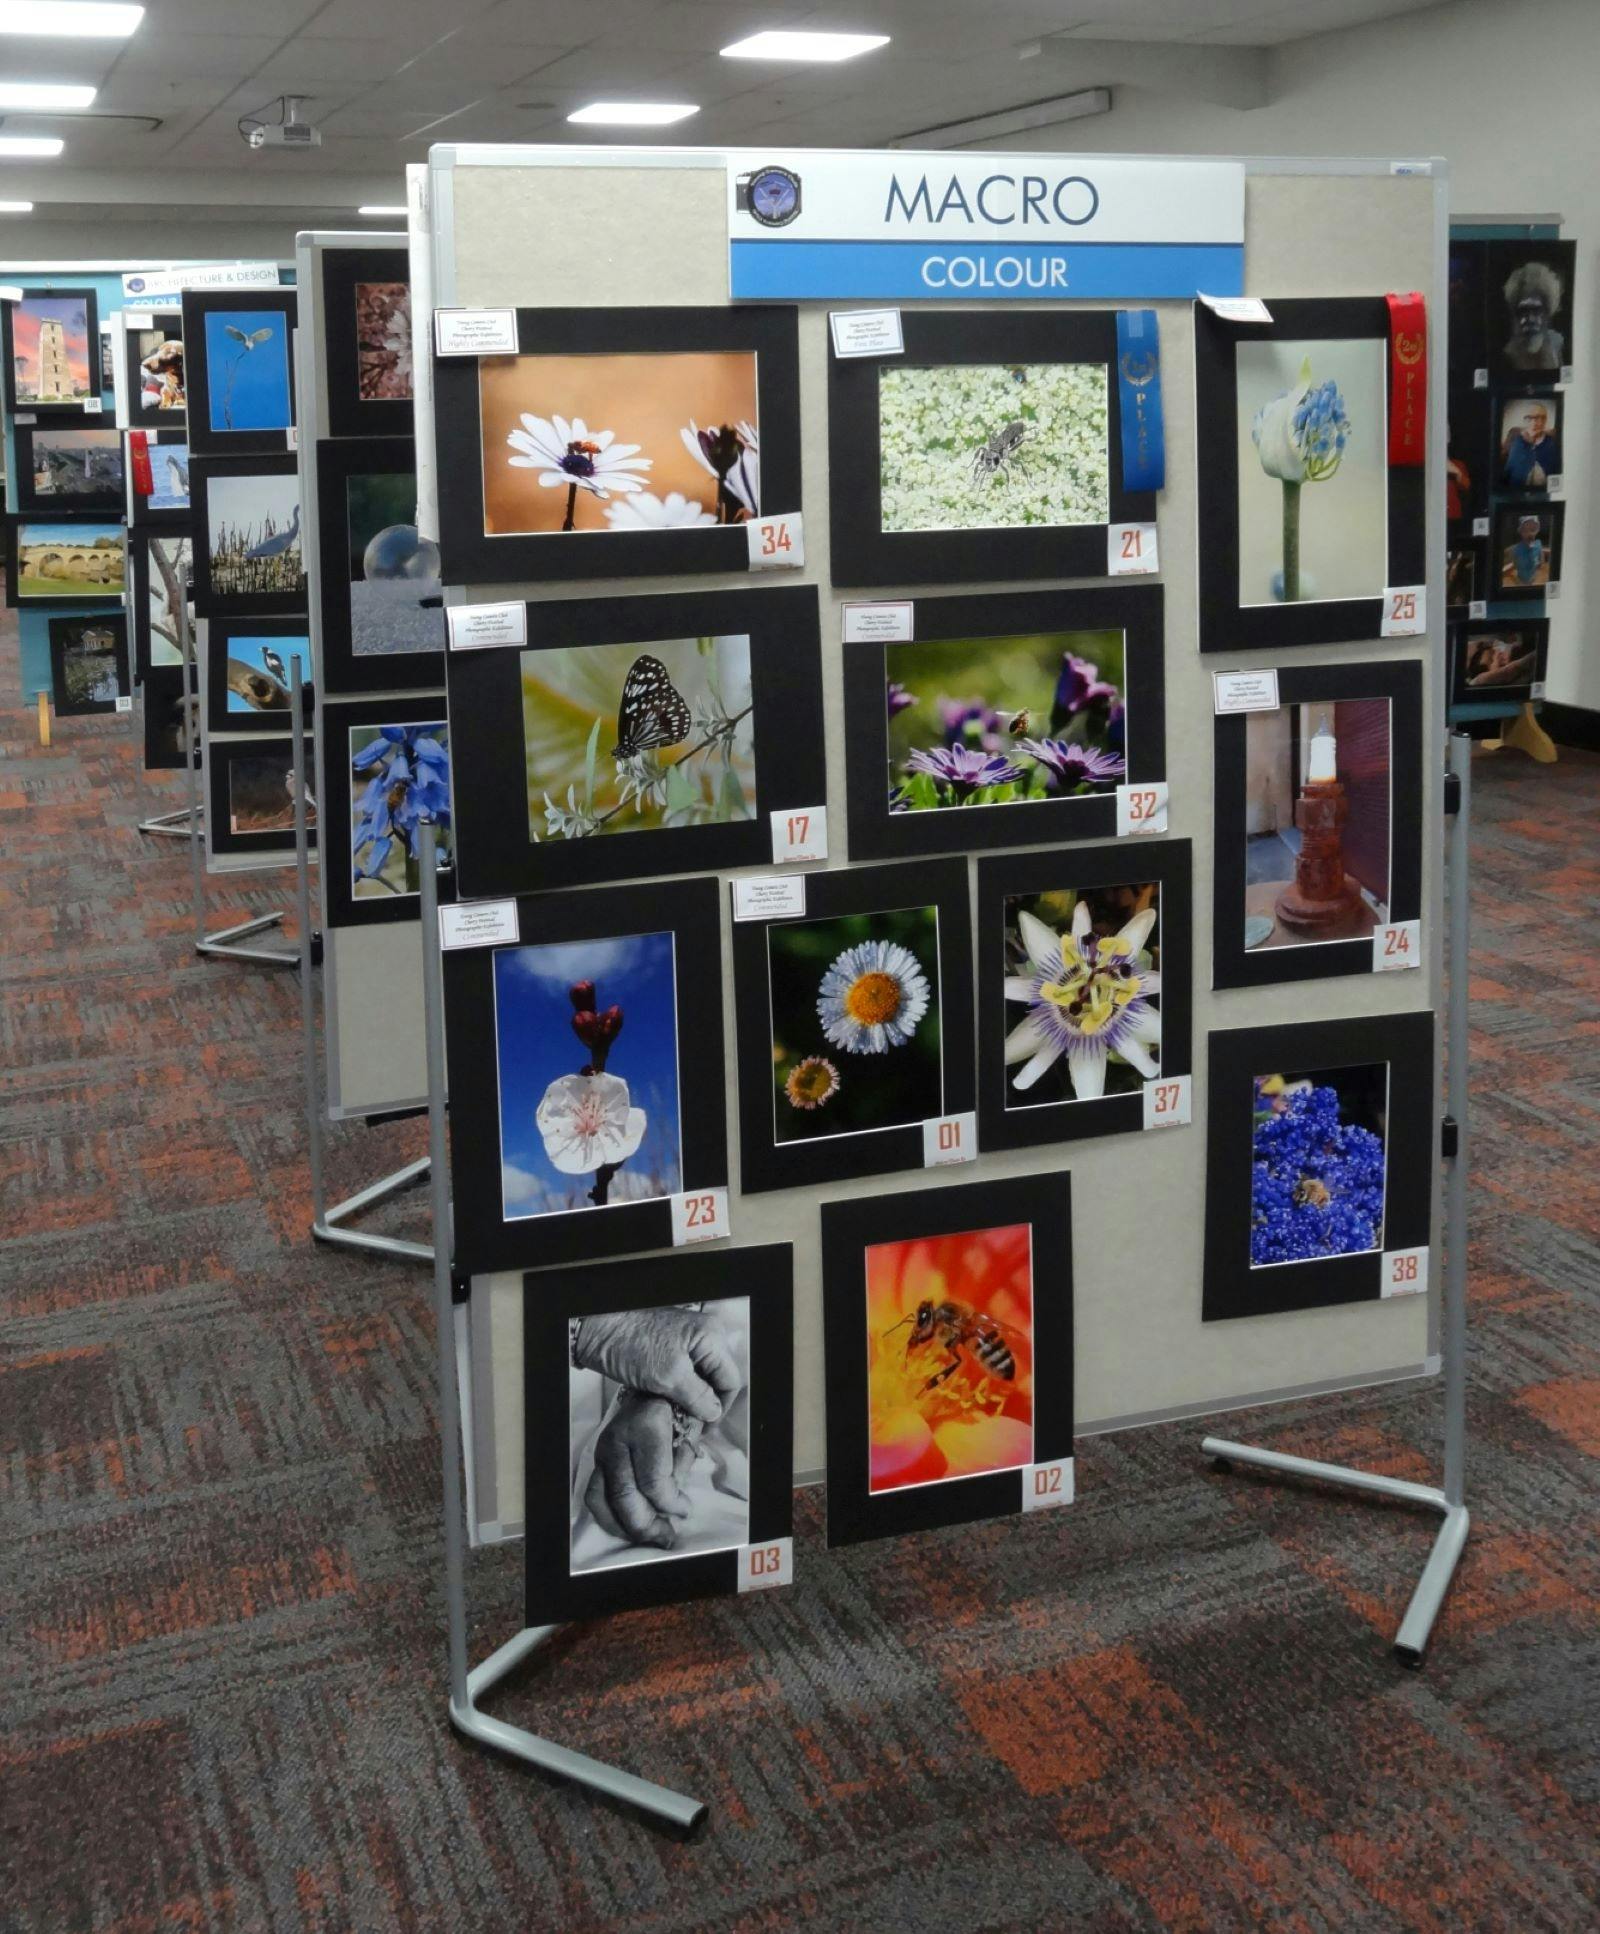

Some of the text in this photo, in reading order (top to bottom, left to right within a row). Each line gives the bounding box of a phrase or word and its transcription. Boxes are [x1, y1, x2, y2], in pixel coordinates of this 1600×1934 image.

[884, 173, 1099, 226] MACRO
[237, 269, 276, 282] DESIGN
[921, 256, 1068, 289] COLOUR
[1403, 372, 1416, 446] PLACE
[761, 523, 791, 556] 34
[1121, 530, 1142, 558] 21
[1391, 593, 1416, 620] 25
[1130, 791, 1157, 820] 32
[787, 815, 810, 845] 17
[1384, 927, 1409, 956] 24
[1154, 1083, 1181, 1113] 37
[939, 1121, 961, 1150] 01
[685, 1195, 716, 1228] 23
[1392, 1255, 1417, 1283] 38
[1035, 1466, 1062, 1496] 02
[750, 1546, 780, 1576] 03
